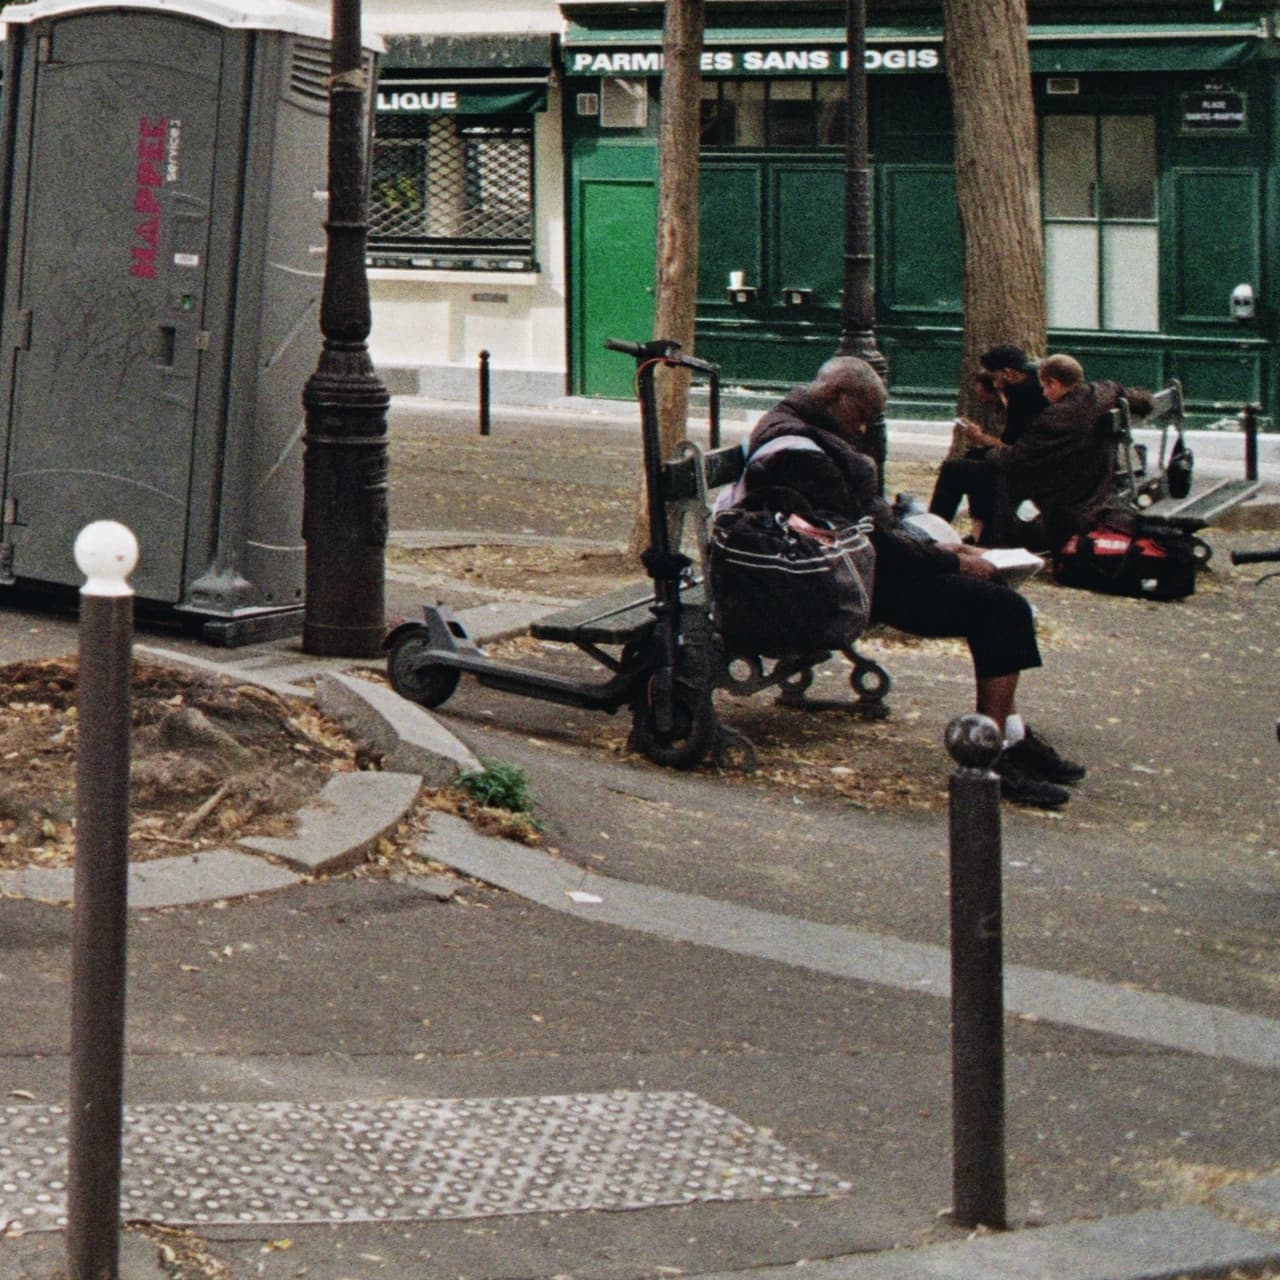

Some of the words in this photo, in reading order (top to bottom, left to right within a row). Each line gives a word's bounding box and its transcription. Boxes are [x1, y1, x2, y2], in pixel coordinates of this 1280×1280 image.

[572, 52, 665, 70] PARM
[699, 51, 735, 70] ES
[743, 50, 830, 70] SANS
[375, 91, 458, 110] LIQUE
[128, 116, 168, 279] HAPPEE
